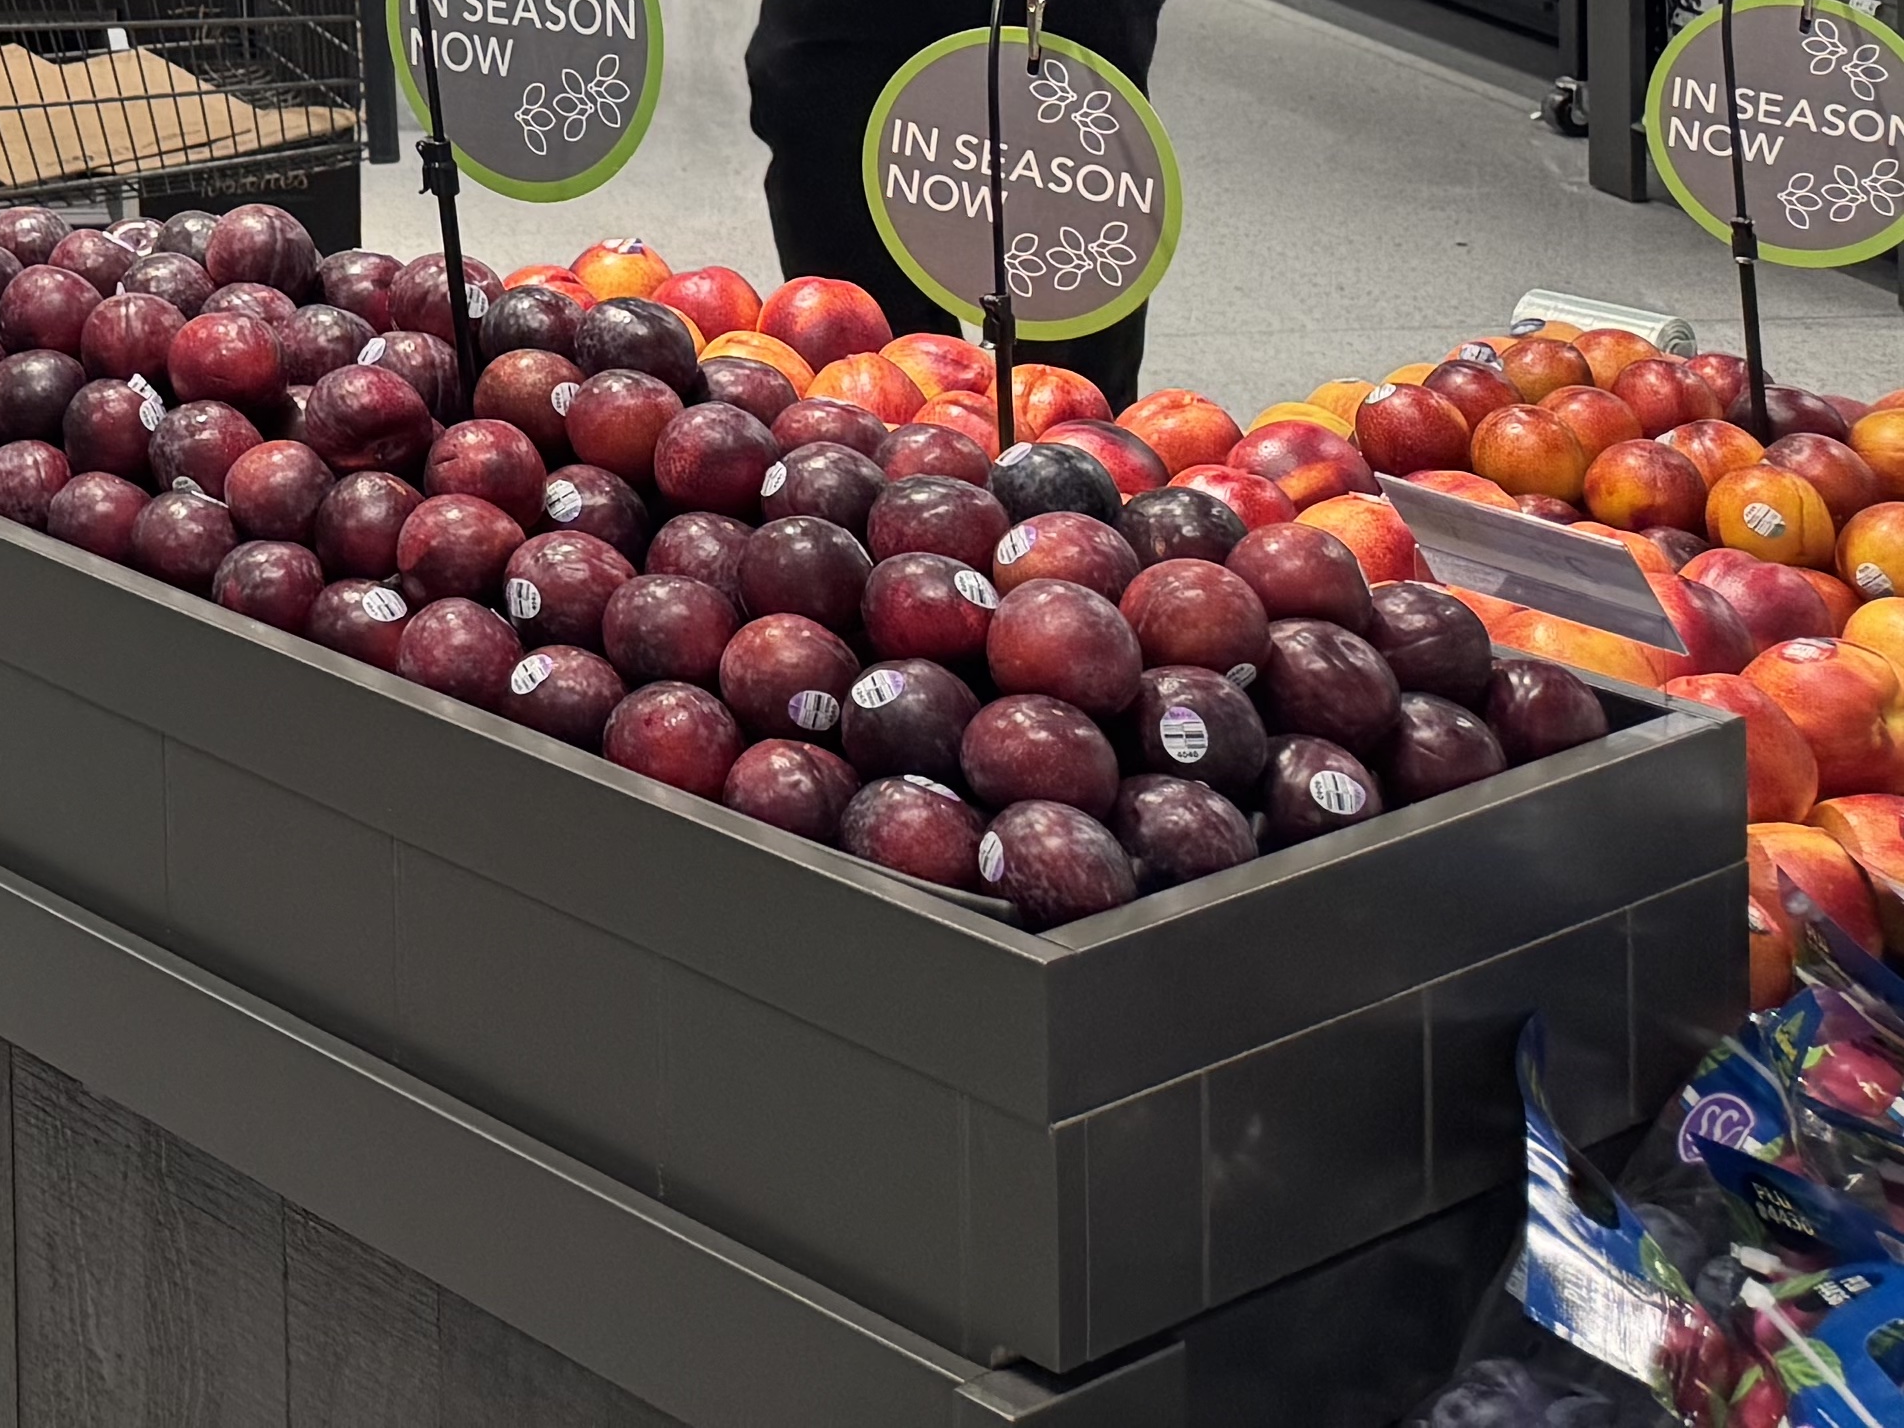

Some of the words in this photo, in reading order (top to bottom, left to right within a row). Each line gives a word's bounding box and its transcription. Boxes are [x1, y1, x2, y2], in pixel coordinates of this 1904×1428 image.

[409, 26, 514, 78] NOW
[1671, 76, 1717, 114] IN
[890, 117, 939, 162] IN
[952, 132, 1155, 214] SEASON
[1667, 116, 1786, 166] NOW
[886, 162, 1007, 224] NOW
